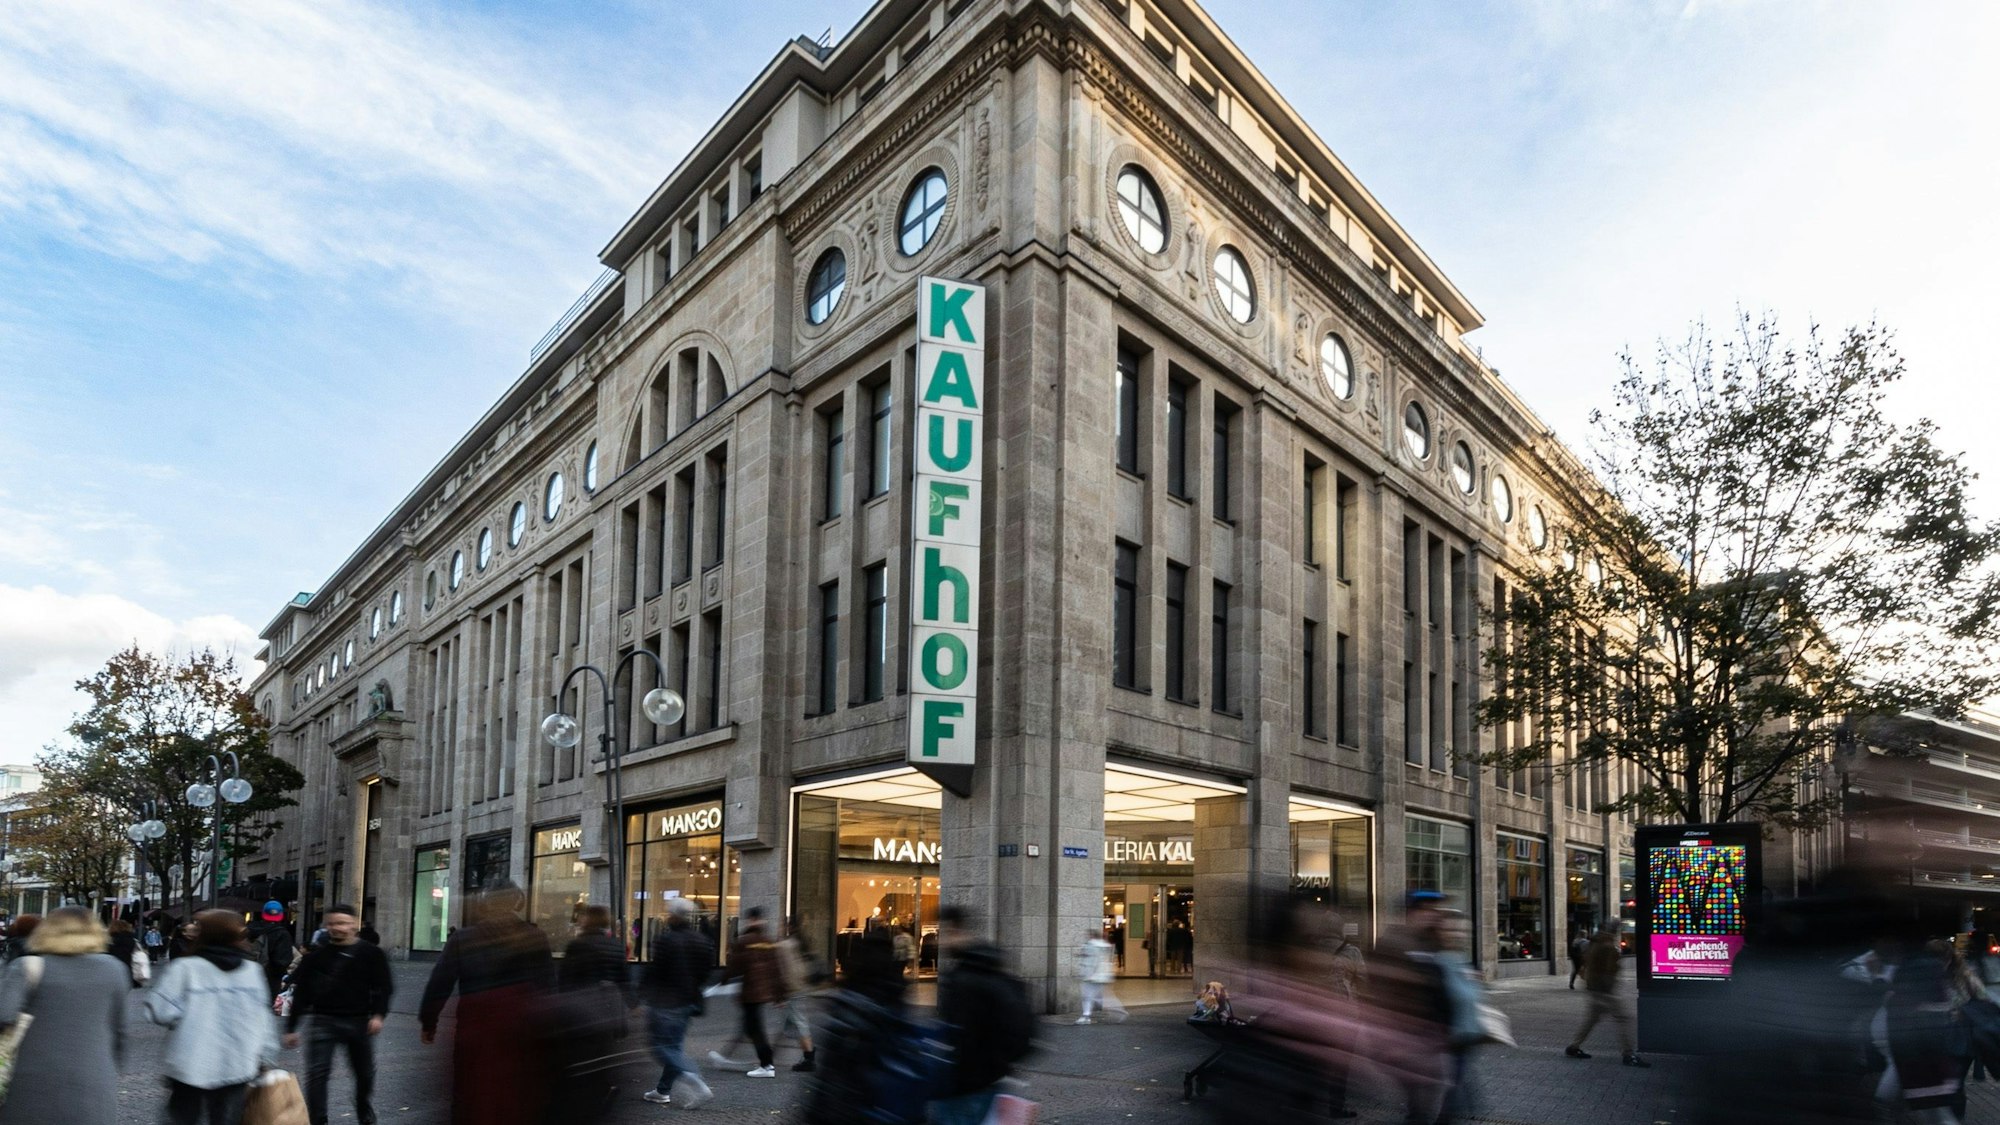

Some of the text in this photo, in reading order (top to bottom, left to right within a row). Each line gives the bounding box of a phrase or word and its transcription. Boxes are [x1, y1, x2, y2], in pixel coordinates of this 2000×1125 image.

[661, 807, 722, 836] MANGO
[873, 838, 942, 863] MAN
[1104, 841, 1157, 861] LERIA
